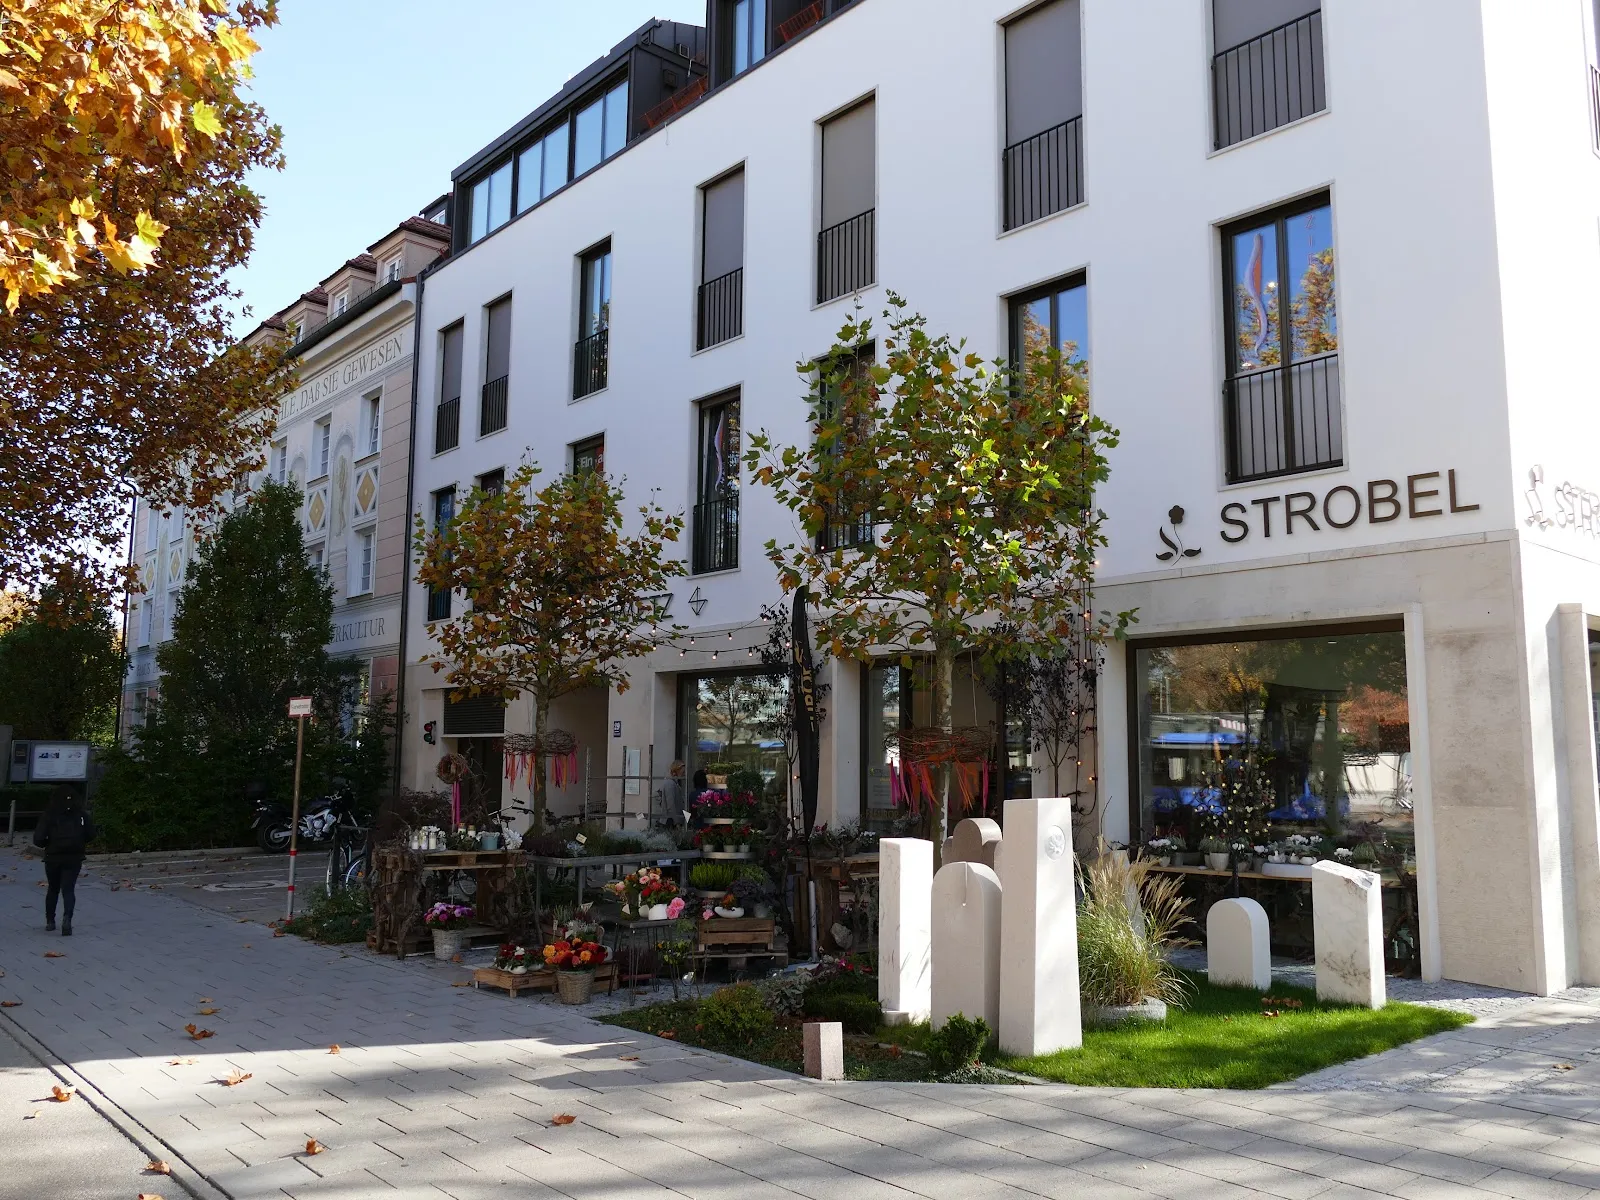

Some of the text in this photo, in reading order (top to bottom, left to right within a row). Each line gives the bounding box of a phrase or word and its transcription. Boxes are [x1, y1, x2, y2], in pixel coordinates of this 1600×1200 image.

[322, 370, 339, 397] SIE
[343, 333, 404, 384] GEWESEN
[1220, 468, 1480, 543] STROBEL
